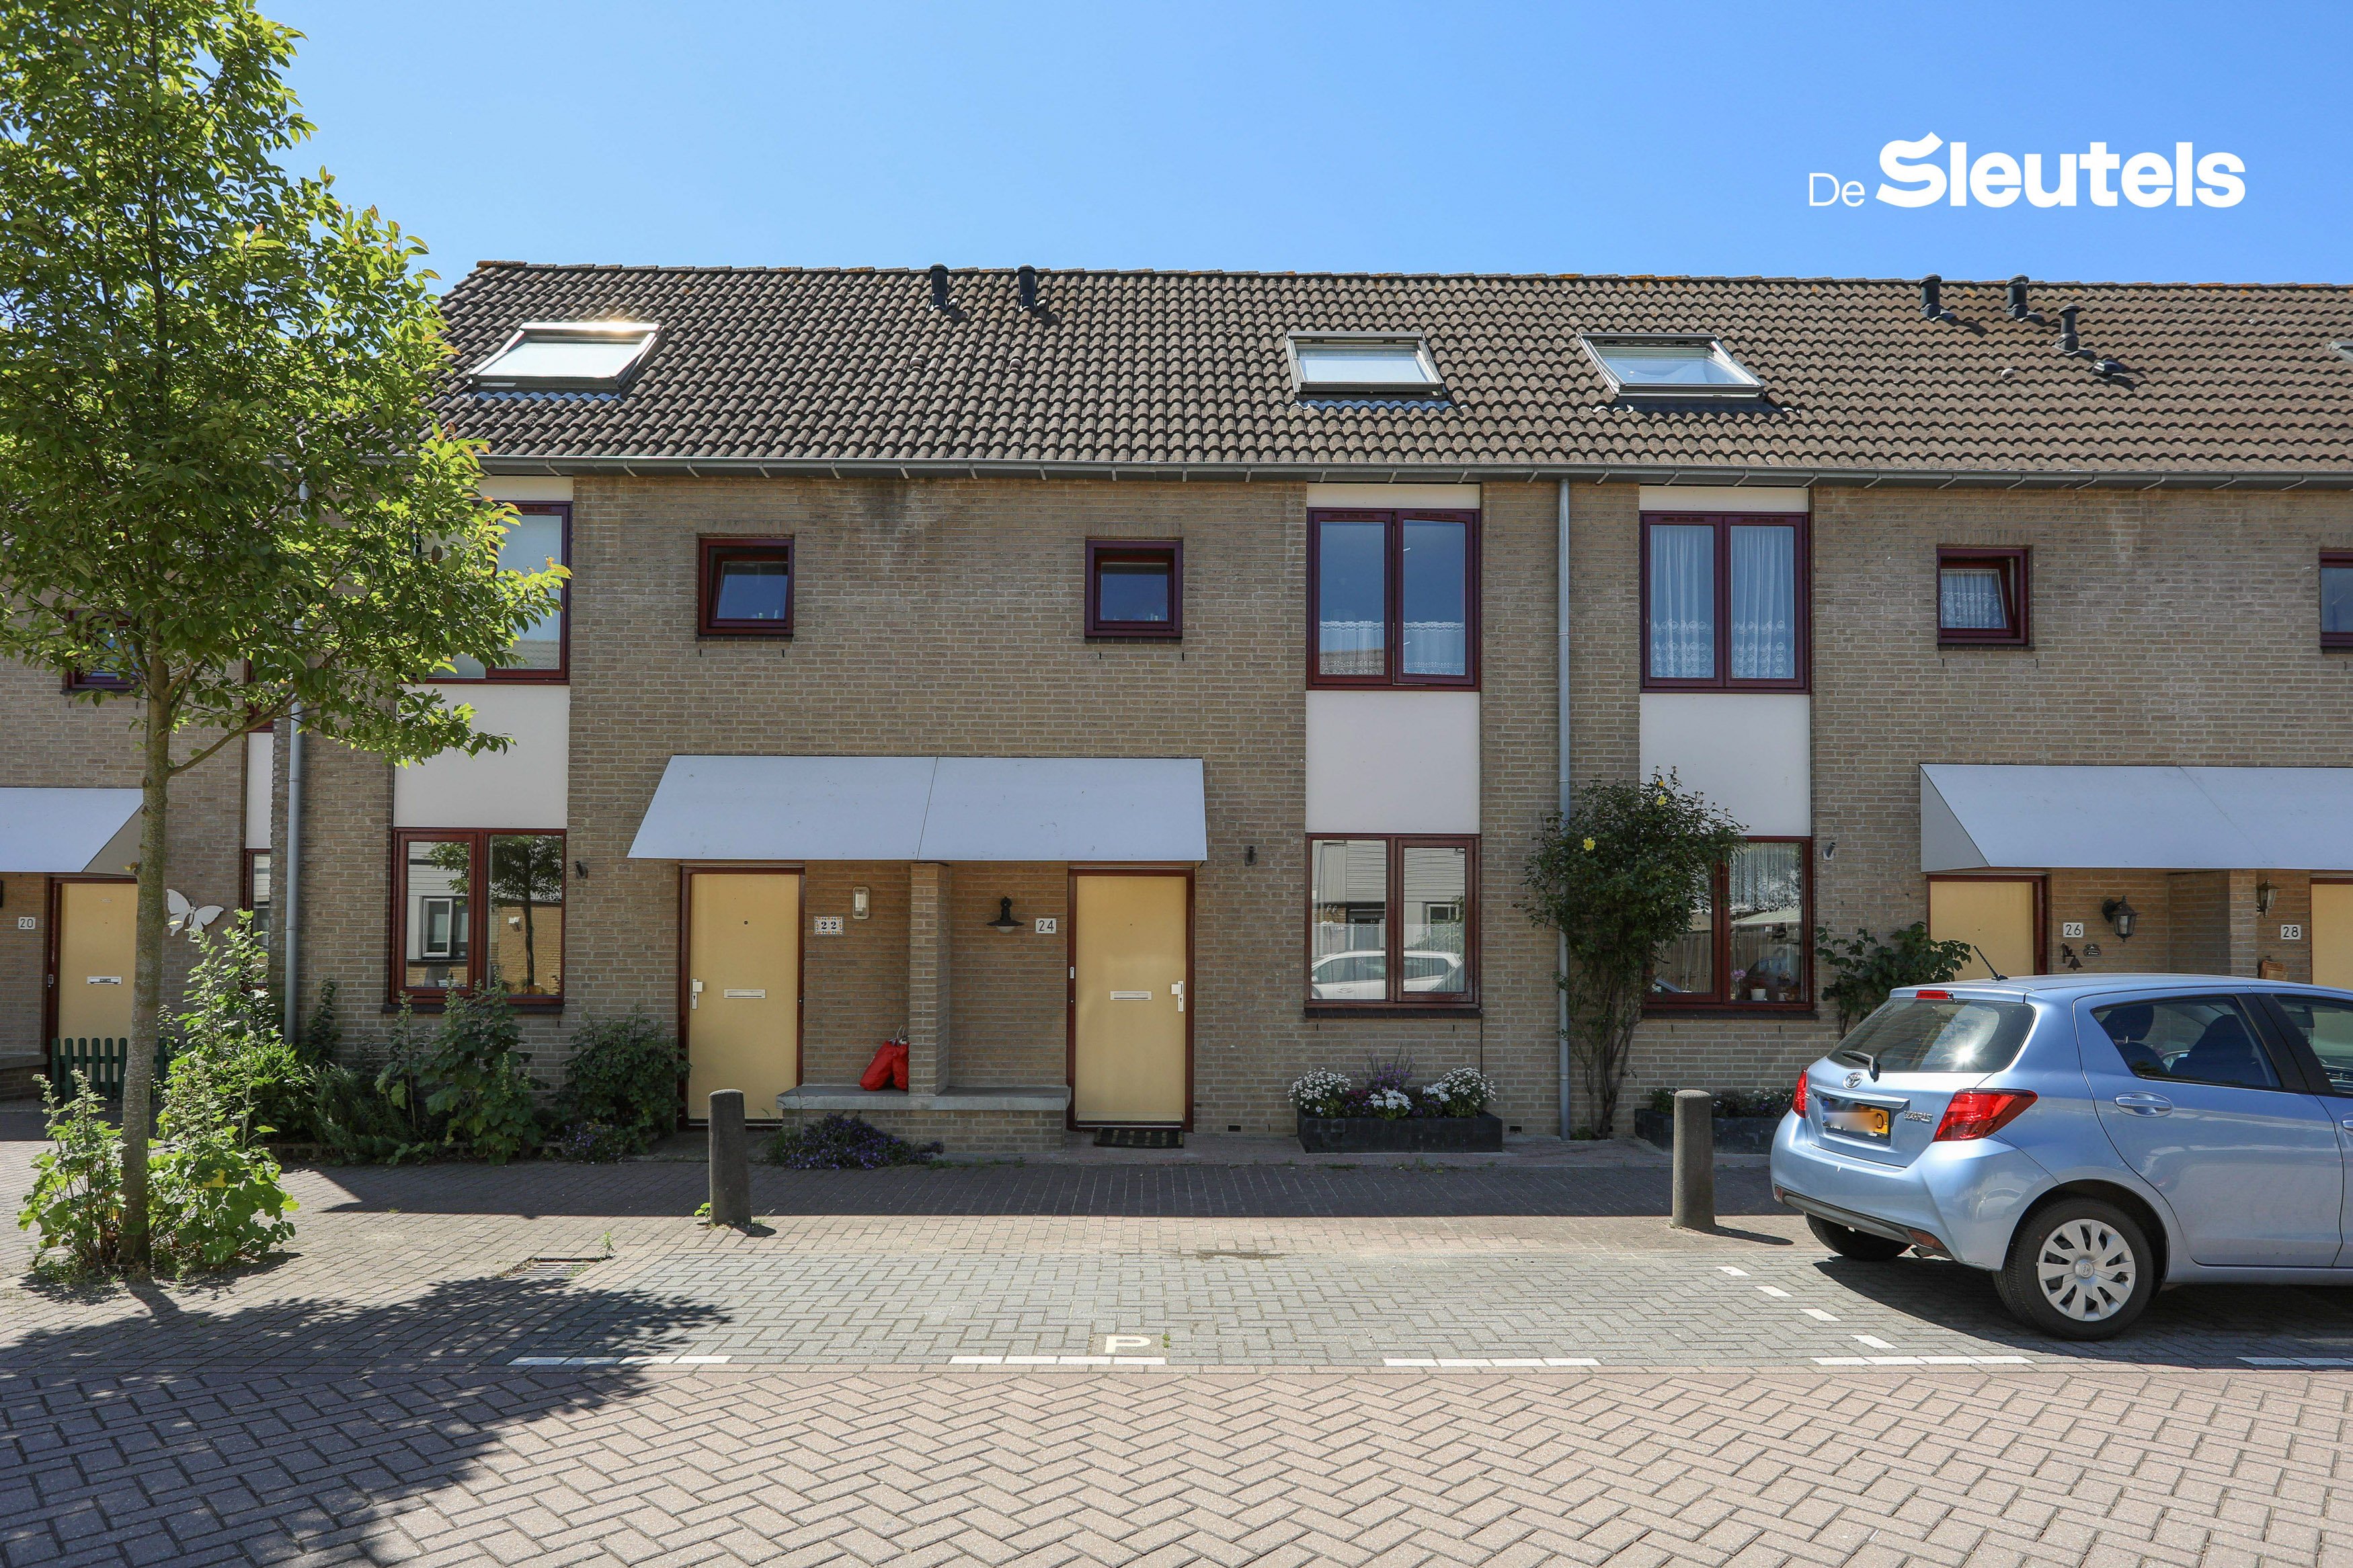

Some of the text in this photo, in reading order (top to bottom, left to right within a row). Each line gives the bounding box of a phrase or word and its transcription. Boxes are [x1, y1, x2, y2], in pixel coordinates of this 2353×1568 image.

[20, 918, 34, 928] 20
[821, 921, 837, 930] 22
[1039, 920, 1054, 932] 24
[2066, 924, 2081, 936] 26
[2283, 926, 2299, 938] 28
[1105, 1335, 1151, 1354] P
